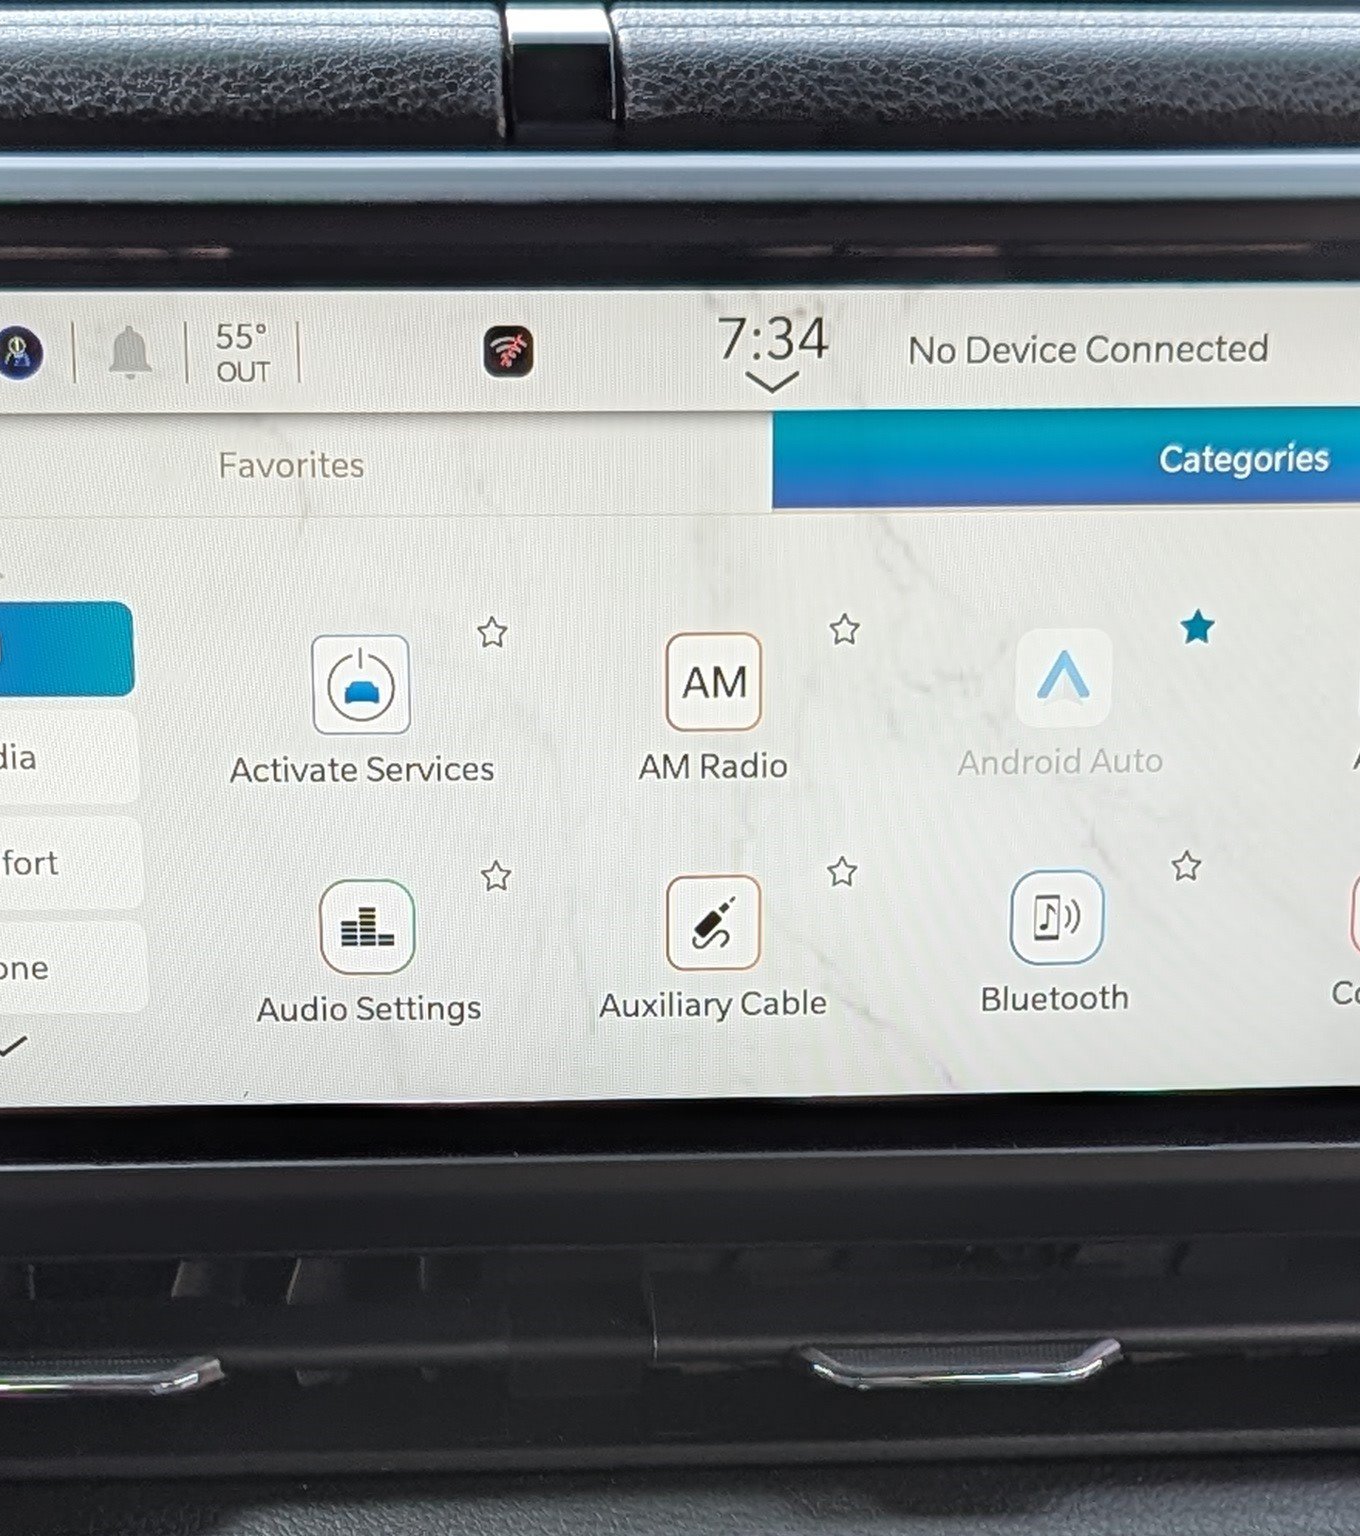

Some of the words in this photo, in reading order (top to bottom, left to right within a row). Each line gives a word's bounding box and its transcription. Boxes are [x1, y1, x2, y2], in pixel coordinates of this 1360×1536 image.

[216, 323, 267, 350] 55°
[717, 316, 829, 361] 7:34
[909, 337, 956, 365] No
[966, 334, 1077, 364] Device
[1085, 333, 1269, 363] Connected
[216, 361, 271, 383] OUT
[219, 450, 364, 479] Favorites
[1160, 441, 1329, 479] Categories
[682, 666, 747, 699] AM
[230, 756, 358, 783] Activate
[365, 756, 494, 783] Services
[638, 755, 690, 781] AM
[700, 752, 788, 780] Radio
[956, 747, 1081, 777] Android
[1089, 747, 1163, 775] Auto
[256, 996, 348, 1024] Audio
[355, 995, 481, 1029] Settings
[599, 992, 733, 1022] Auxiliary
[740, 990, 827, 1017] Cable
[980, 984, 1129, 1012] Bluetooth
